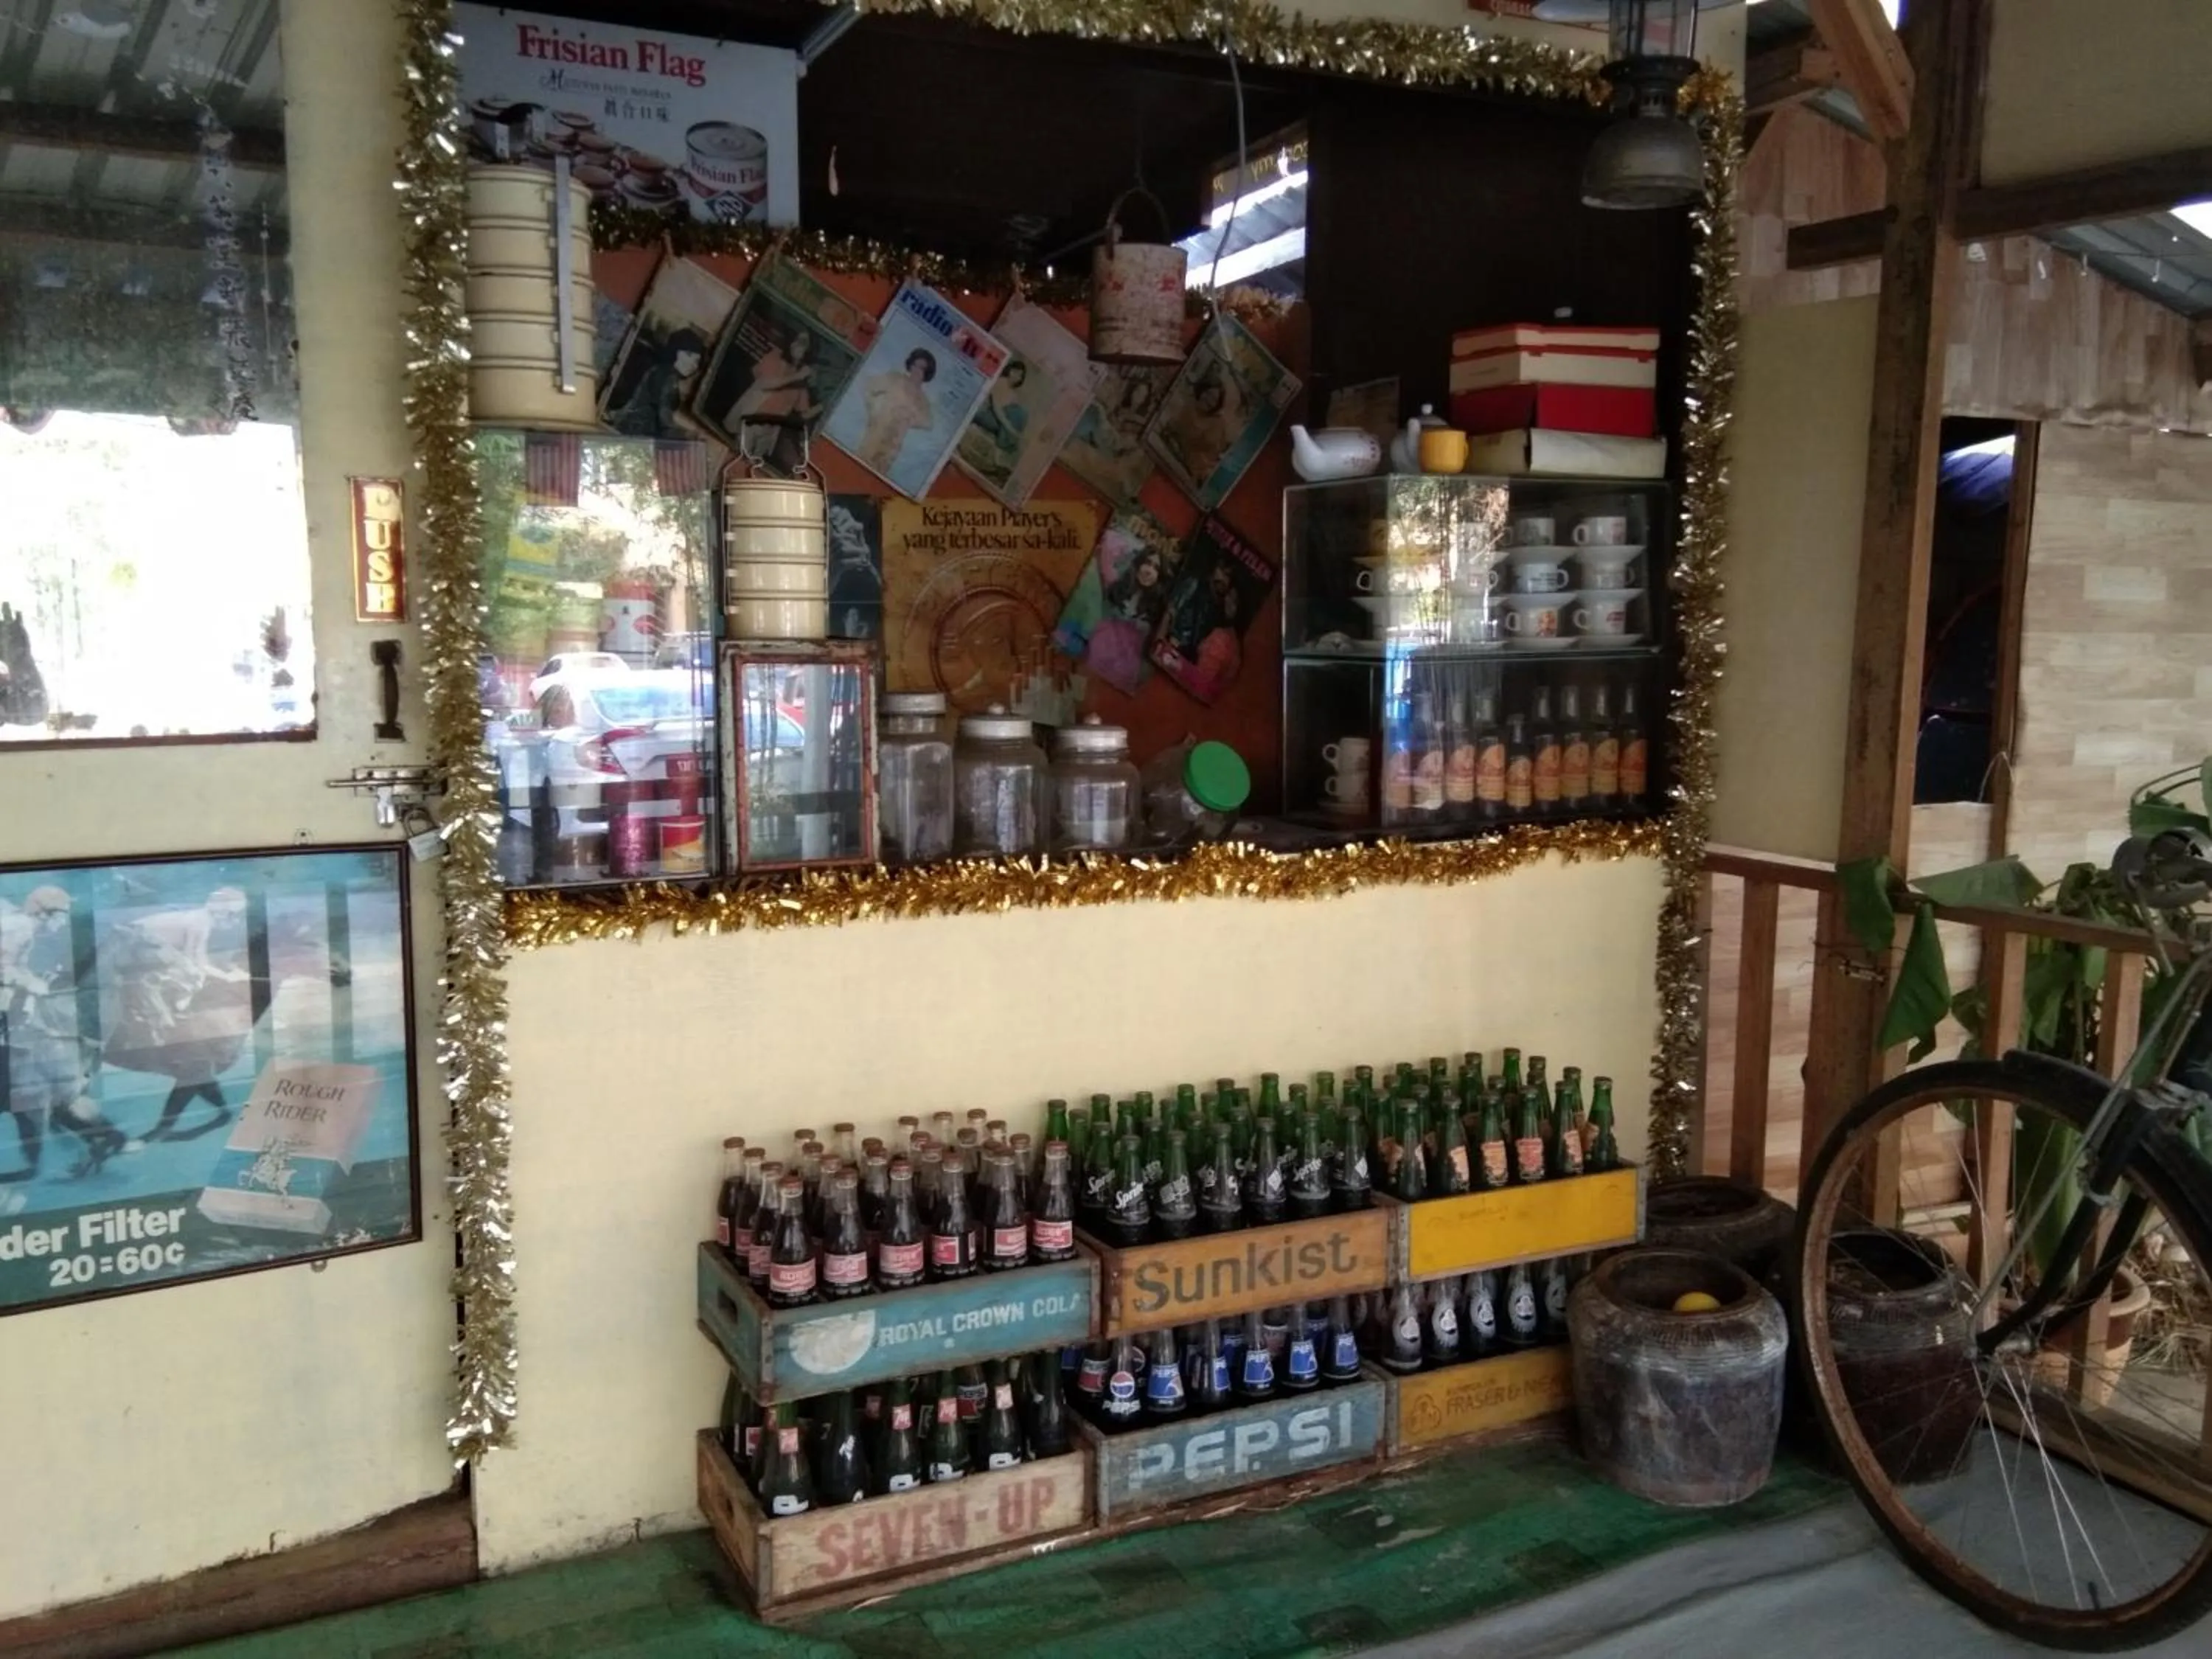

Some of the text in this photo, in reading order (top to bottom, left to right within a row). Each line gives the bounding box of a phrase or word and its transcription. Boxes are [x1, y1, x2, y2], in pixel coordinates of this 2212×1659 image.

[516, 24, 629, 72] Frisian
[636, 41, 706, 87] Flag
[899, 289, 954, 337] radio
[902, 532, 947, 556] yang
[949, 526, 1021, 549] terbesar
[922, 505, 997, 533] Kejayaan
[363, 483, 402, 613] PUSH
[264, 1099, 328, 1123] RIDER
[274, 1078, 346, 1102] ROUGH
[78, 1206, 187, 1249] Filter
[1130, 1230, 1358, 1312] Sunkist
[879, 1317, 947, 1348] ROYAL
[952, 1301, 1025, 1334] CROWN
[1126, 1401, 1353, 1491] PEPSI
[815, 1477, 1059, 1579] SEVEN-UP
